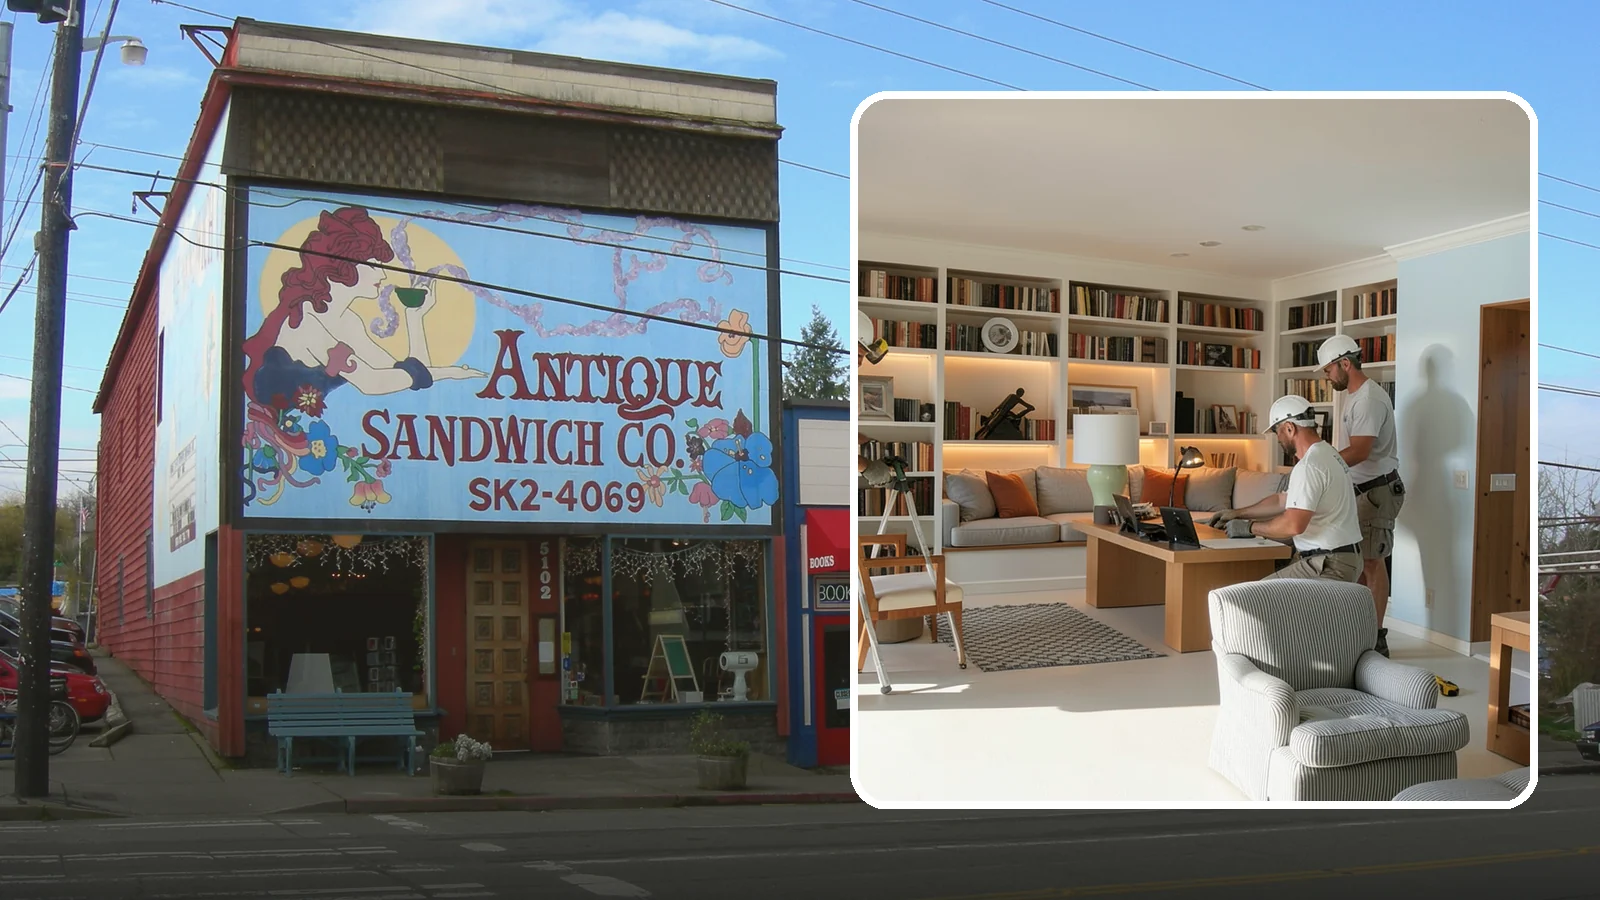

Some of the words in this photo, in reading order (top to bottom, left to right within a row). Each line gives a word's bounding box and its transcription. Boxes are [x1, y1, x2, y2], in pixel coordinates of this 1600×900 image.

[476, 329, 724, 420] ANTIQUE
[361, 409, 605, 467] SANDWICH
[617, 422, 685, 469] CO.
[468, 478, 645, 512] SK2-4069
[540, 541, 551, 599] 5102
[809, 555, 834, 568] BOOKS
